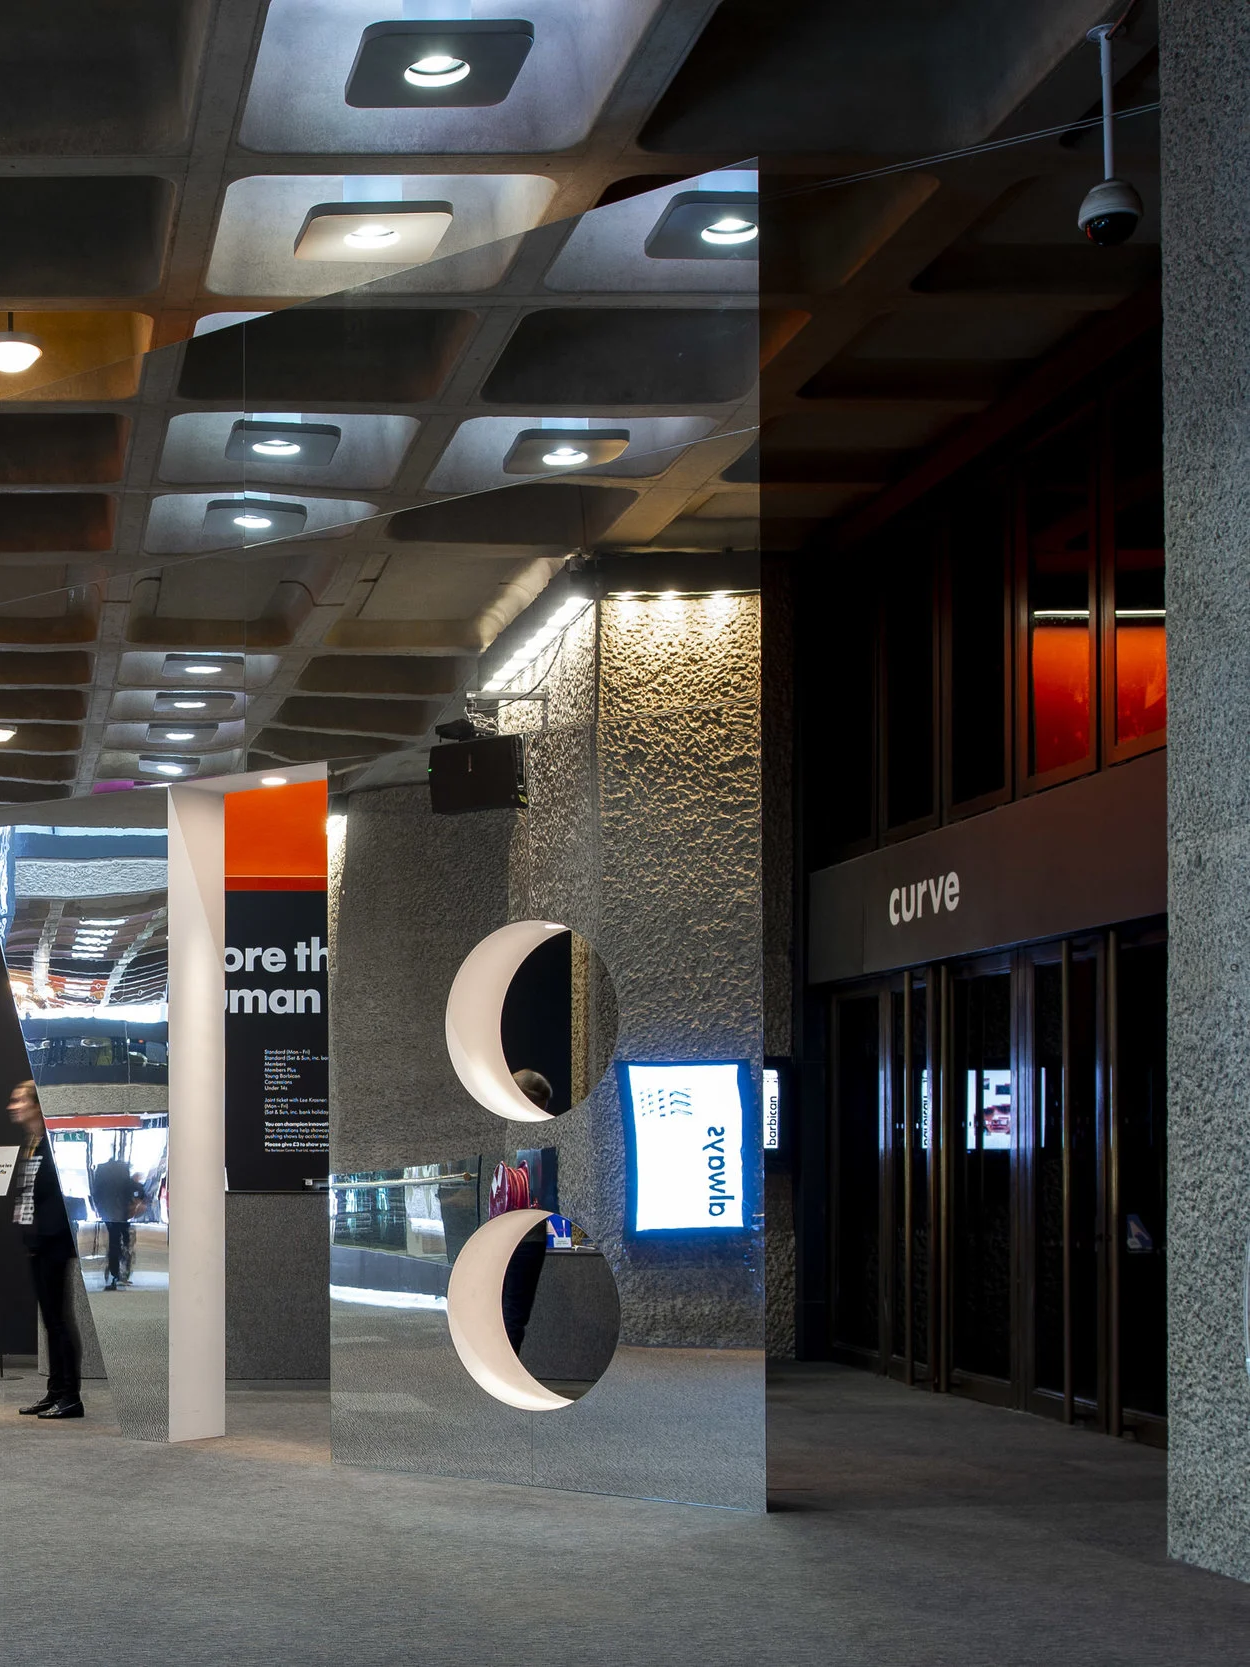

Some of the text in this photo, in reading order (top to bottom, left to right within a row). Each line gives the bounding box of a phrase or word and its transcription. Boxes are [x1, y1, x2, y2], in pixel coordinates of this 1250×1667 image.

[889, 871, 960, 926] curve
[225, 989, 320, 1014] man
[767, 1096, 777, 1146] barbican
